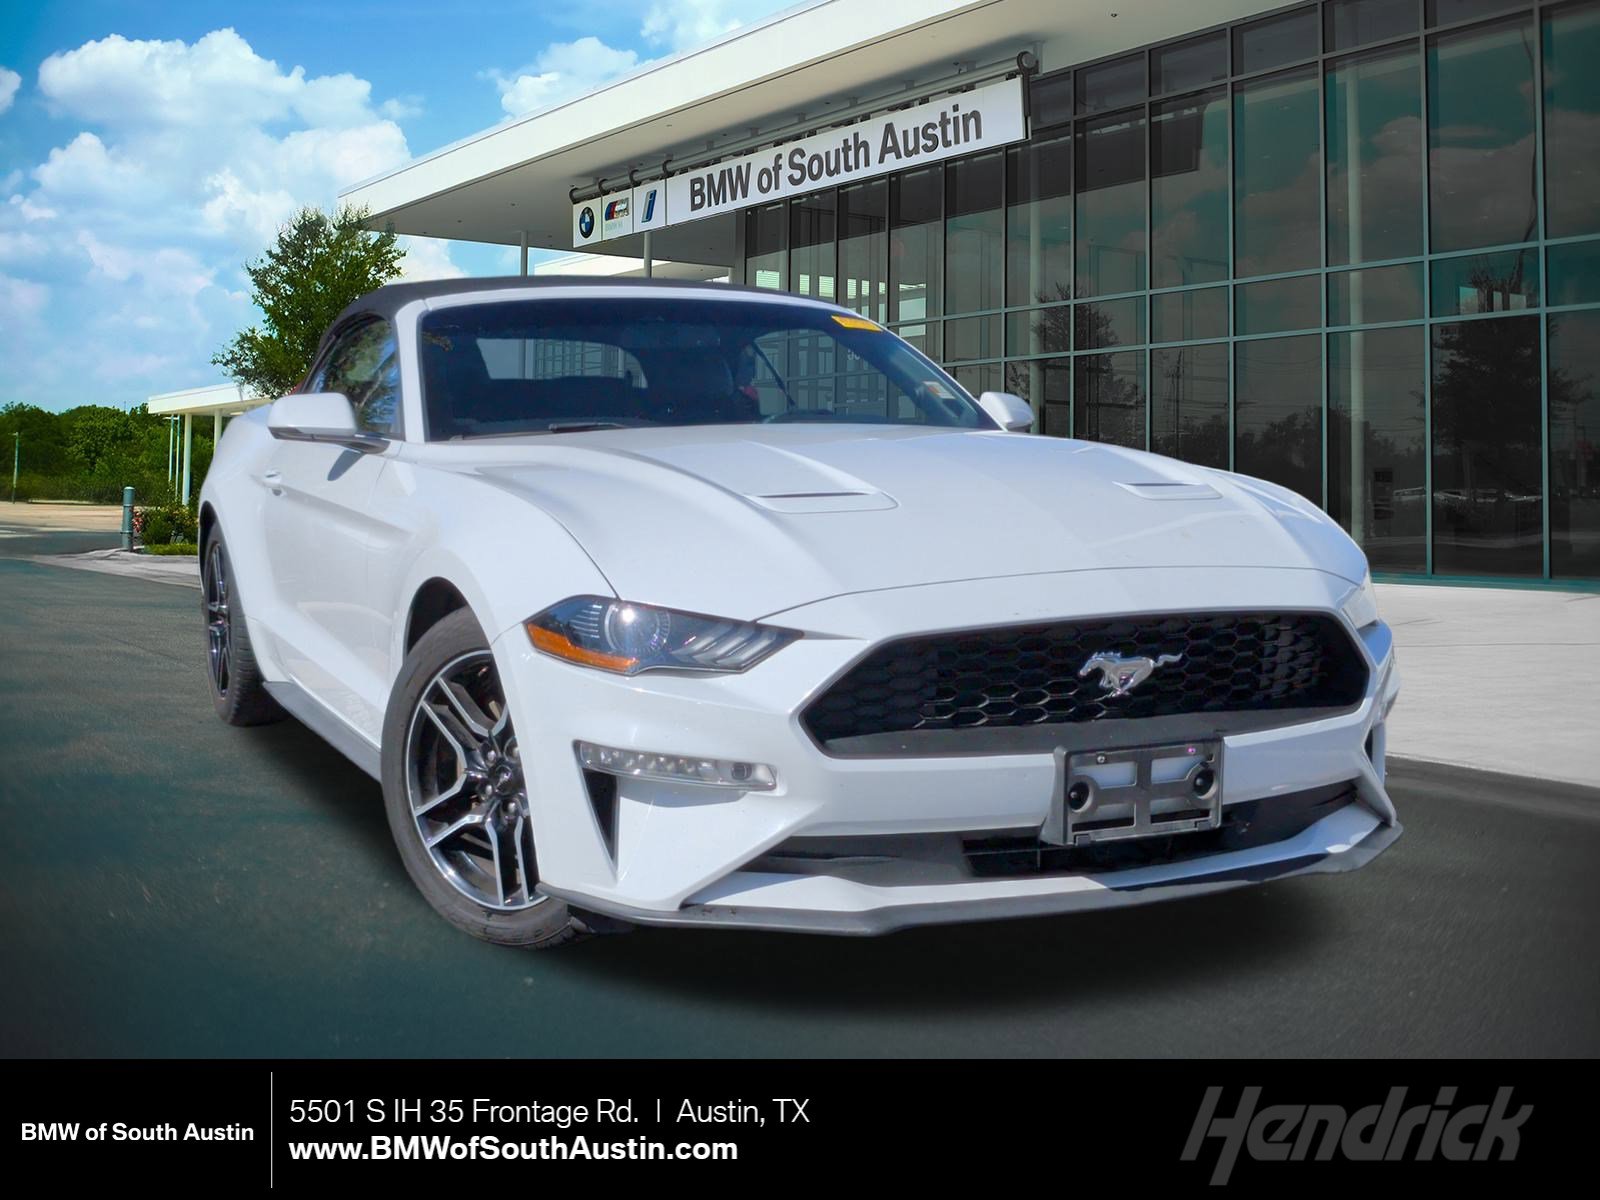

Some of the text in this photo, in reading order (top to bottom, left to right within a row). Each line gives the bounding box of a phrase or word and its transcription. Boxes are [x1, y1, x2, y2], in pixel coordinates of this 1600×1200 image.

[690, 162, 751, 212] BMW
[757, 153, 784, 195] of
[787, 132, 870, 186] South
[878, 103, 983, 165] Austin
